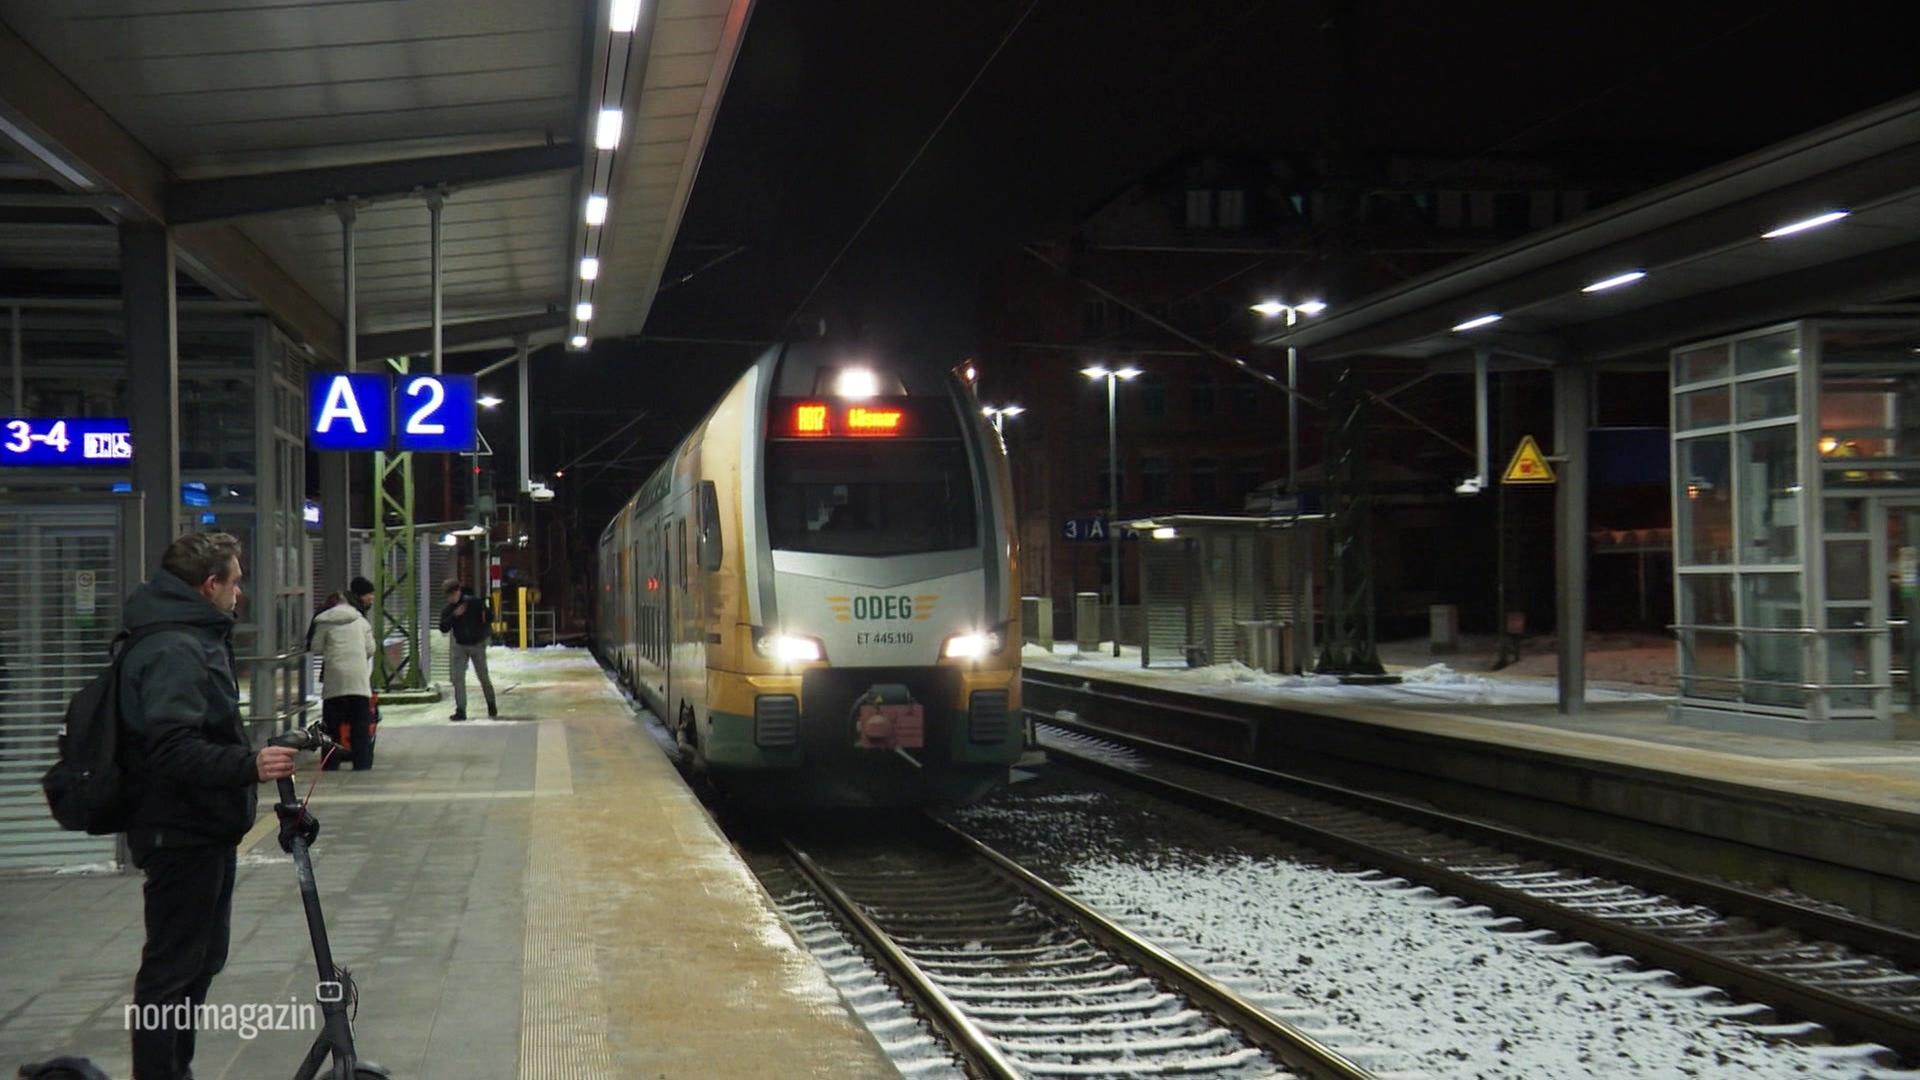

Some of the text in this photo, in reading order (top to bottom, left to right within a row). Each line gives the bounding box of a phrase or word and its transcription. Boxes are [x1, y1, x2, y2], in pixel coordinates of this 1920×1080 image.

[316, 375, 367, 433] A
[406, 376, 445, 434] 2
[5, 420, 71, 453] 3-4
[1065, 520, 1104, 538] 3 A
[853, 595, 912, 620] ODEG
[857, 632, 869, 645] ET
